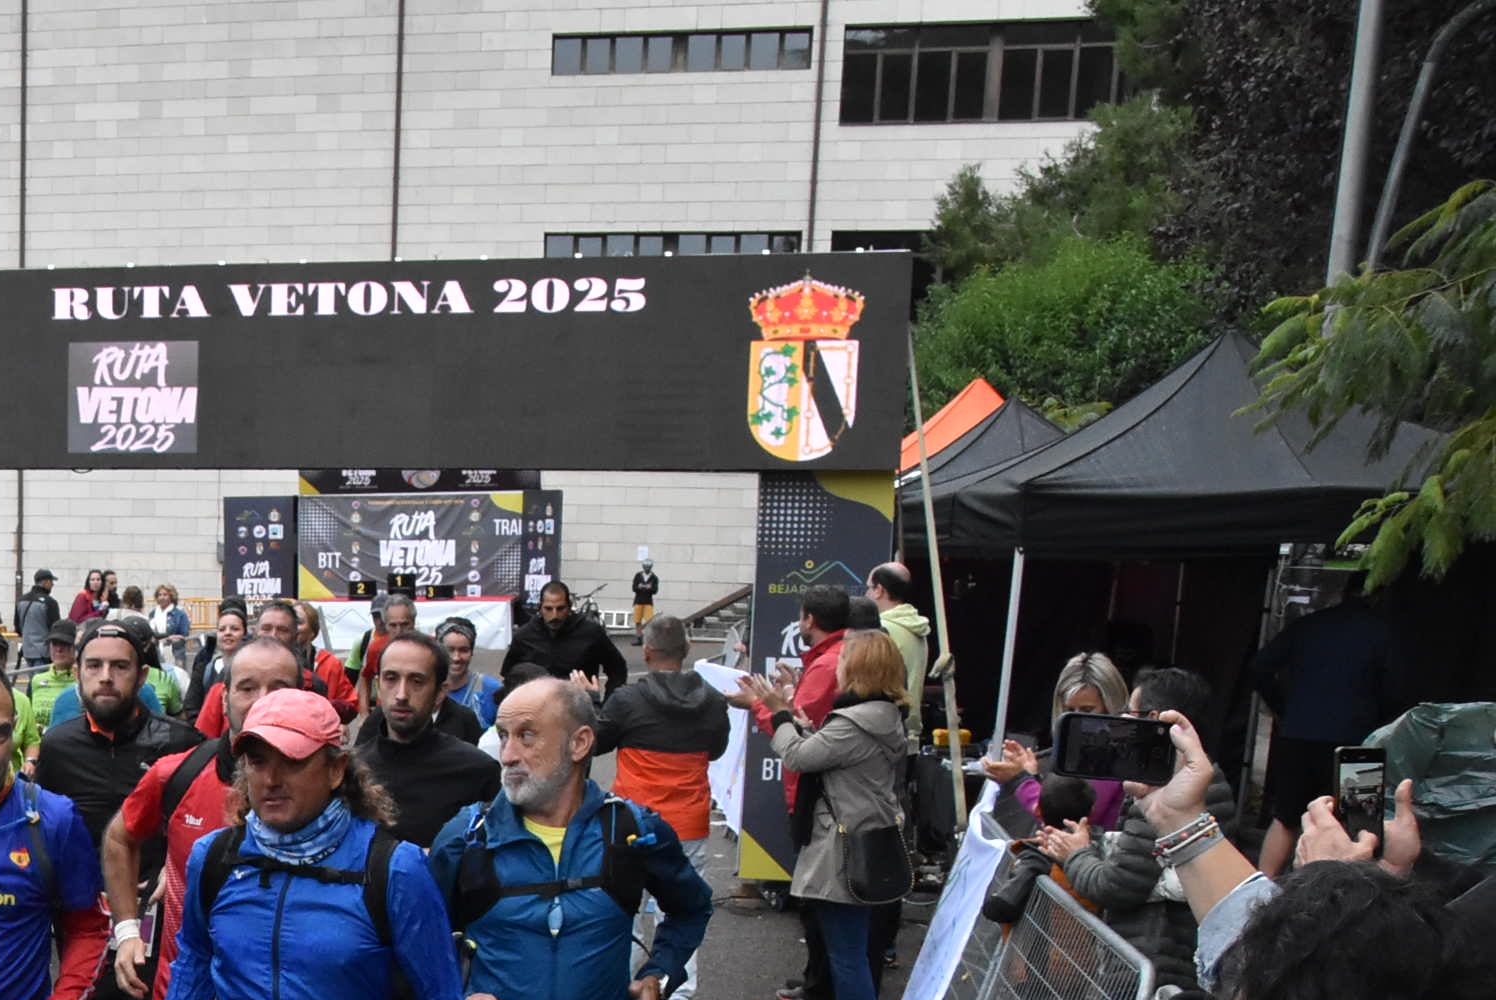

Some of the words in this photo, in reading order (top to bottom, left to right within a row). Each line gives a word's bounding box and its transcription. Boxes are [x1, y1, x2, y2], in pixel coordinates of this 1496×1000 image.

[51, 283, 211, 321] RUTA
[228, 279, 474, 317] VETONA
[492, 277, 647, 313] 2025
[92, 342, 169, 386] RUTA
[76, 386, 198, 425] VETONA
[90, 423, 177, 453] 2025
[389, 510, 436, 540] RUTA
[493, 518, 522, 536] TRAI
[318, 552, 342, 569] BTT
[379, 539, 456, 567] VETONA
[236, 577, 282, 596] VETONA
[356, 582, 365, 595] 2
[395, 575, 403, 587] 1
[427, 586, 435, 598] 3
